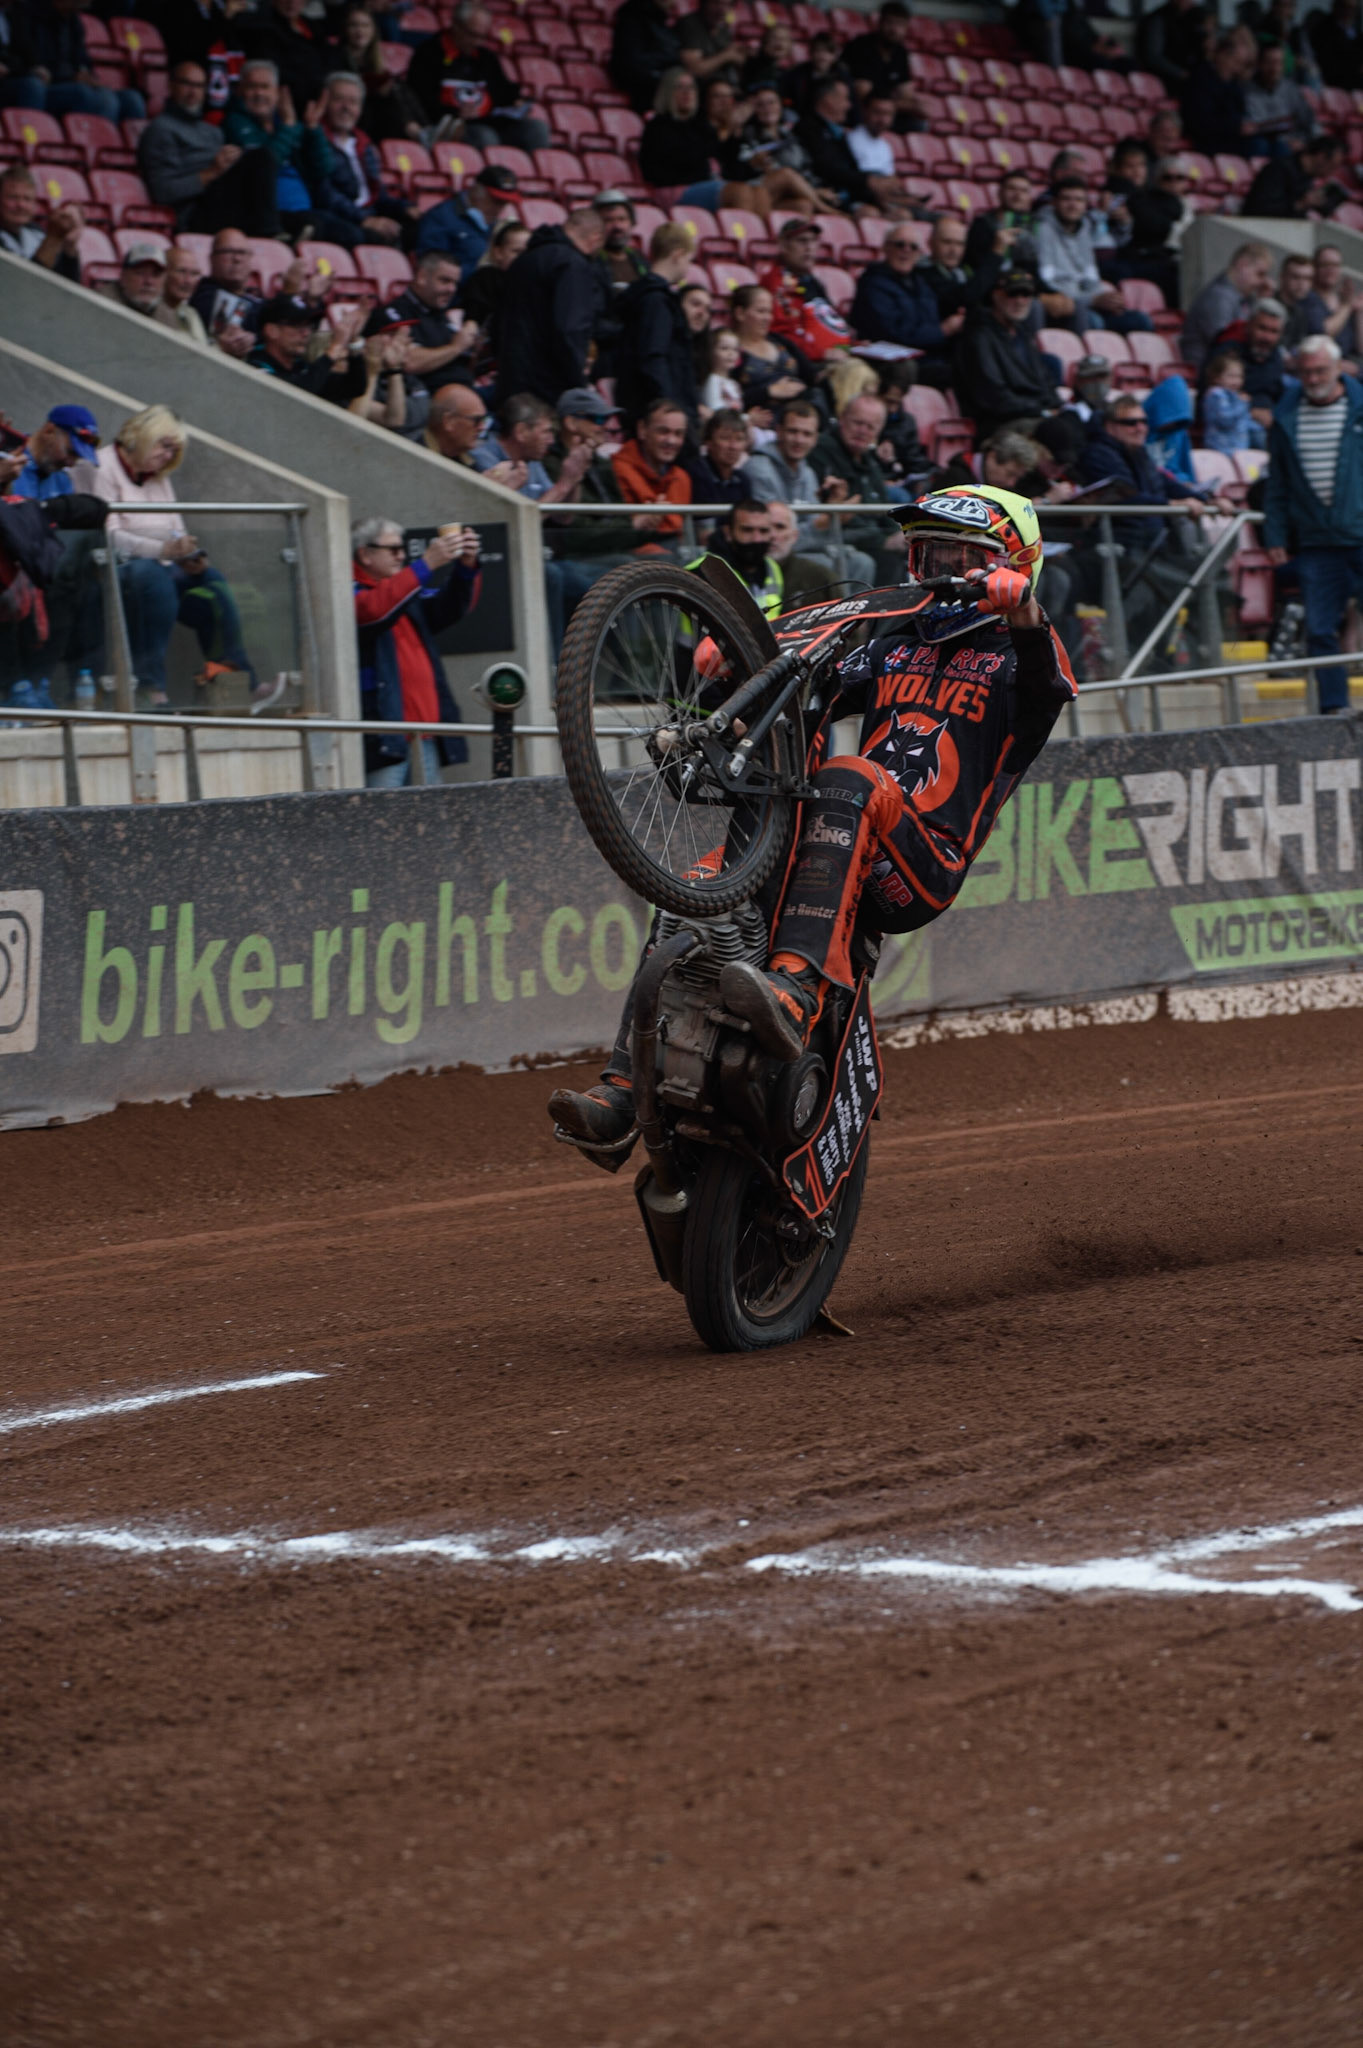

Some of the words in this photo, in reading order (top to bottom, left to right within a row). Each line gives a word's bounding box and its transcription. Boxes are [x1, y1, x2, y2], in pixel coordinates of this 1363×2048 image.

[874, 673, 990, 723] WOLVES
[80, 879, 655, 1044] bike-right.co
[858, 1015, 878, 1092] JWP
